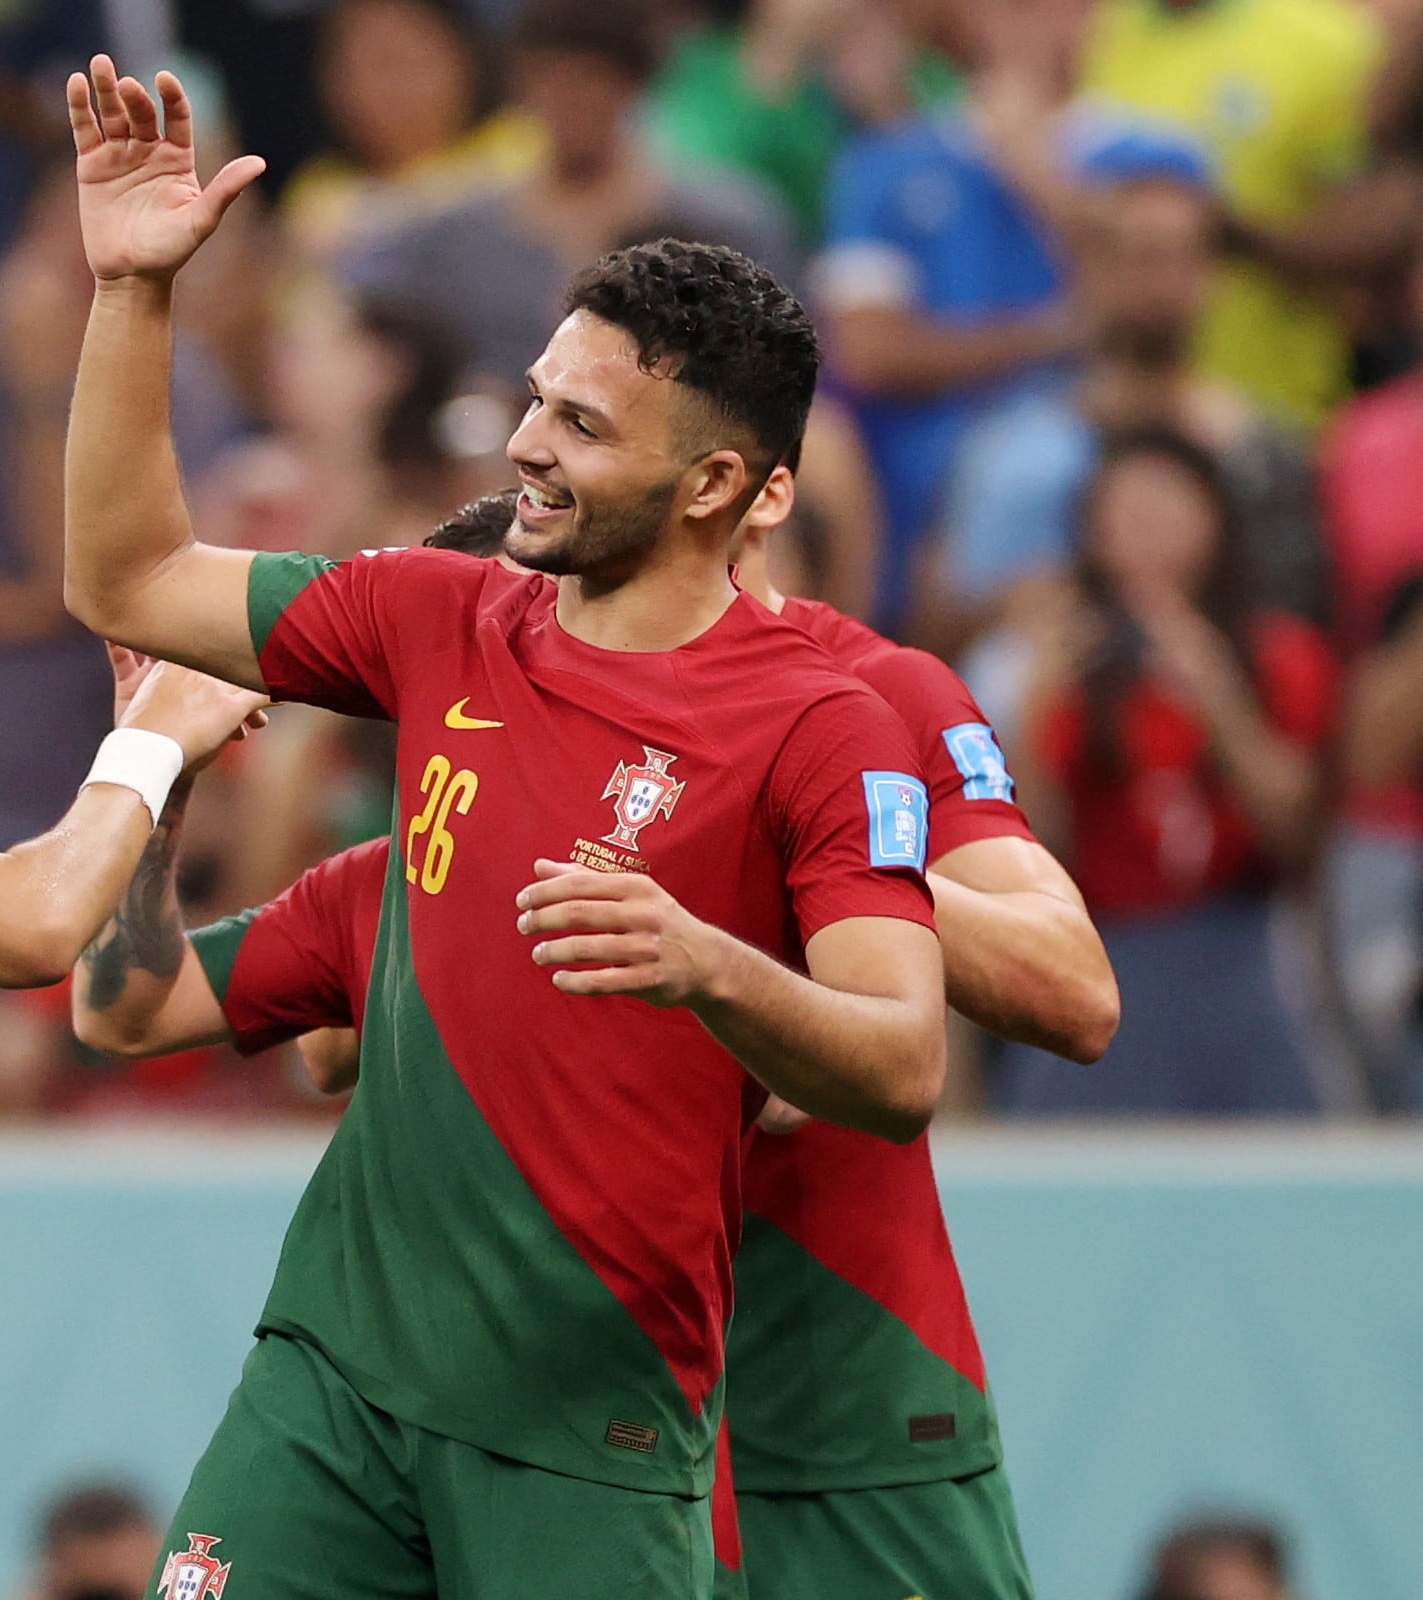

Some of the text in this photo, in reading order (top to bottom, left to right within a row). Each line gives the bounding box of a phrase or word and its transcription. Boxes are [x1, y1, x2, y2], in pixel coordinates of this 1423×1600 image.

[405, 754, 479, 895] 26
[569, 850, 577, 860] 6
[576, 851, 588, 864] DE
[574, 838, 617, 862] PORTUGAL
